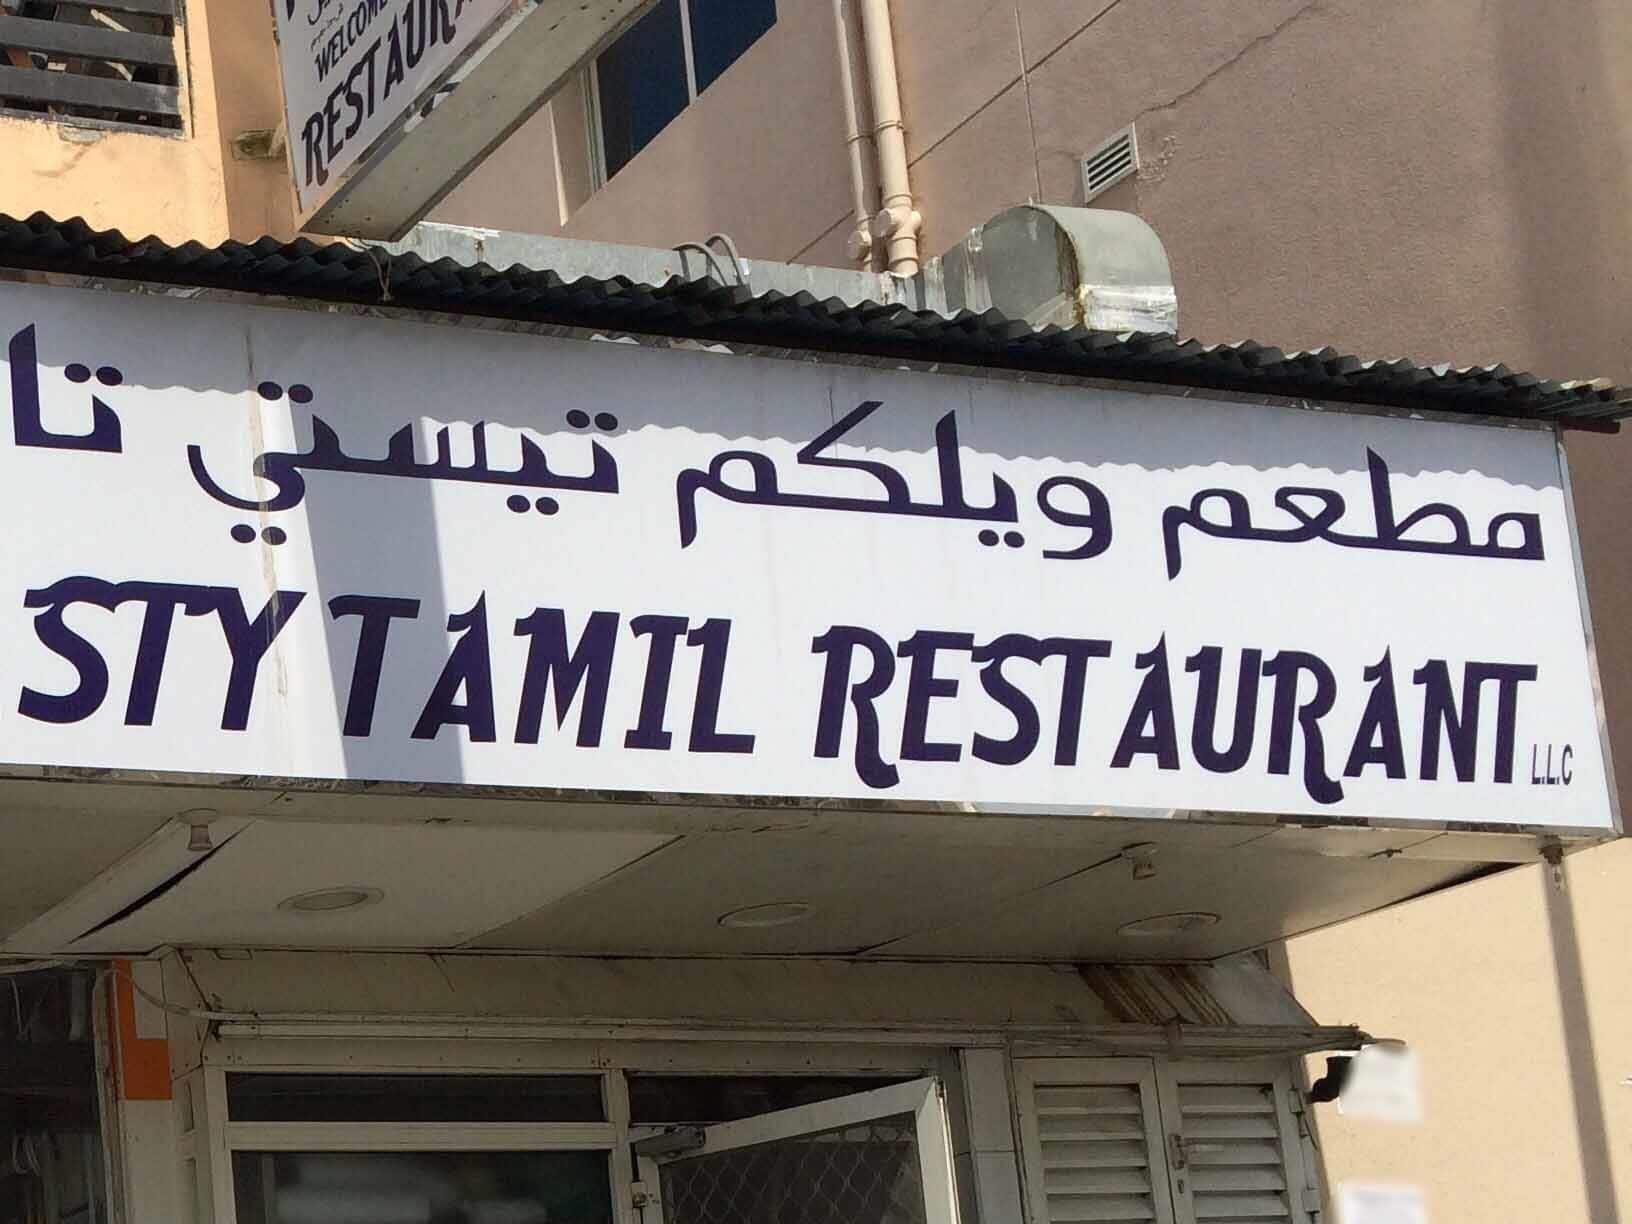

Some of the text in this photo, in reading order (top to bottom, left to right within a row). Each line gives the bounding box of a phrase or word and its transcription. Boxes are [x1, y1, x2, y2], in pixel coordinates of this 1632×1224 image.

[301, 0, 465, 186] RESTAUR
[315, 0, 389, 82] WELCOM
[187, 380, 619, 546] تيستي
[676, 399, 1113, 560] ويلكم
[1163, 444, 1546, 580] مطعم
[328, 590, 756, 754] TAMIL
[811, 625, 1538, 802] RESTAURANT
